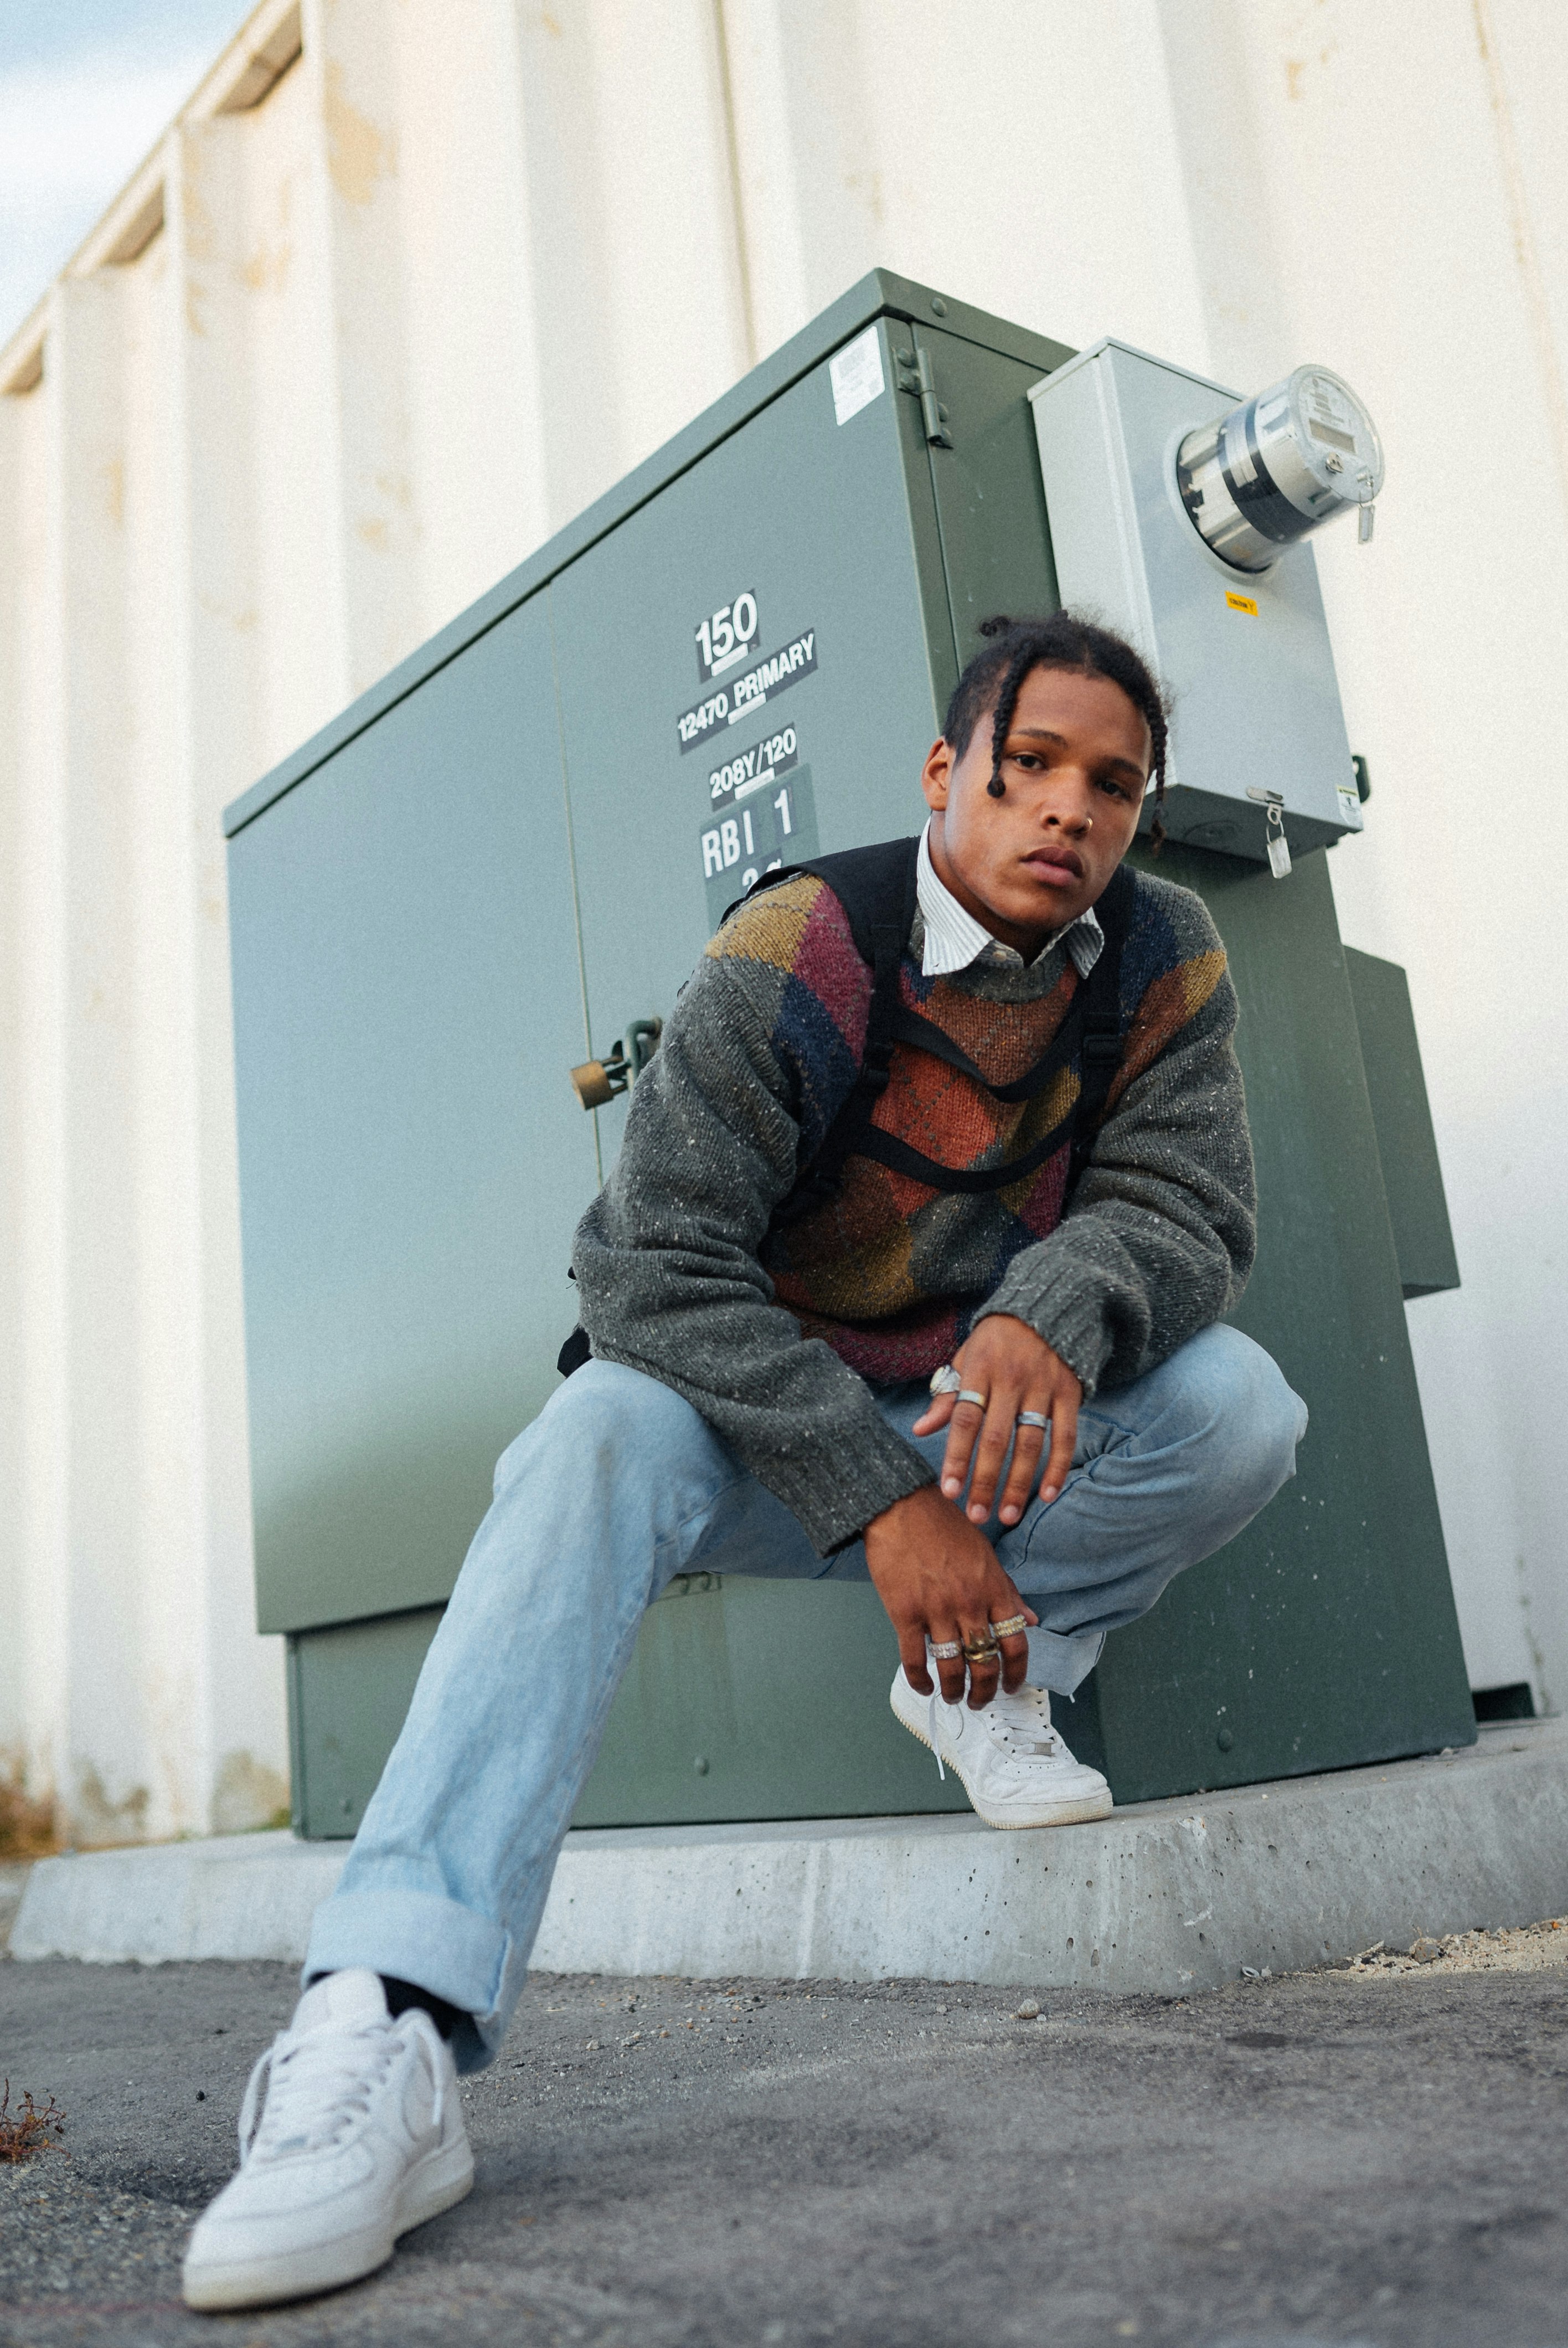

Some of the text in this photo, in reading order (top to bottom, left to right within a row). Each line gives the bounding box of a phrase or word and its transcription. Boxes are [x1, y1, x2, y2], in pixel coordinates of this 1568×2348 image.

[695, 593, 757, 666] 150
[677, 633, 814, 742] 12470 PRIMARY
[709, 728, 797, 799] 208Y/120
[774, 788, 792, 835] 1
